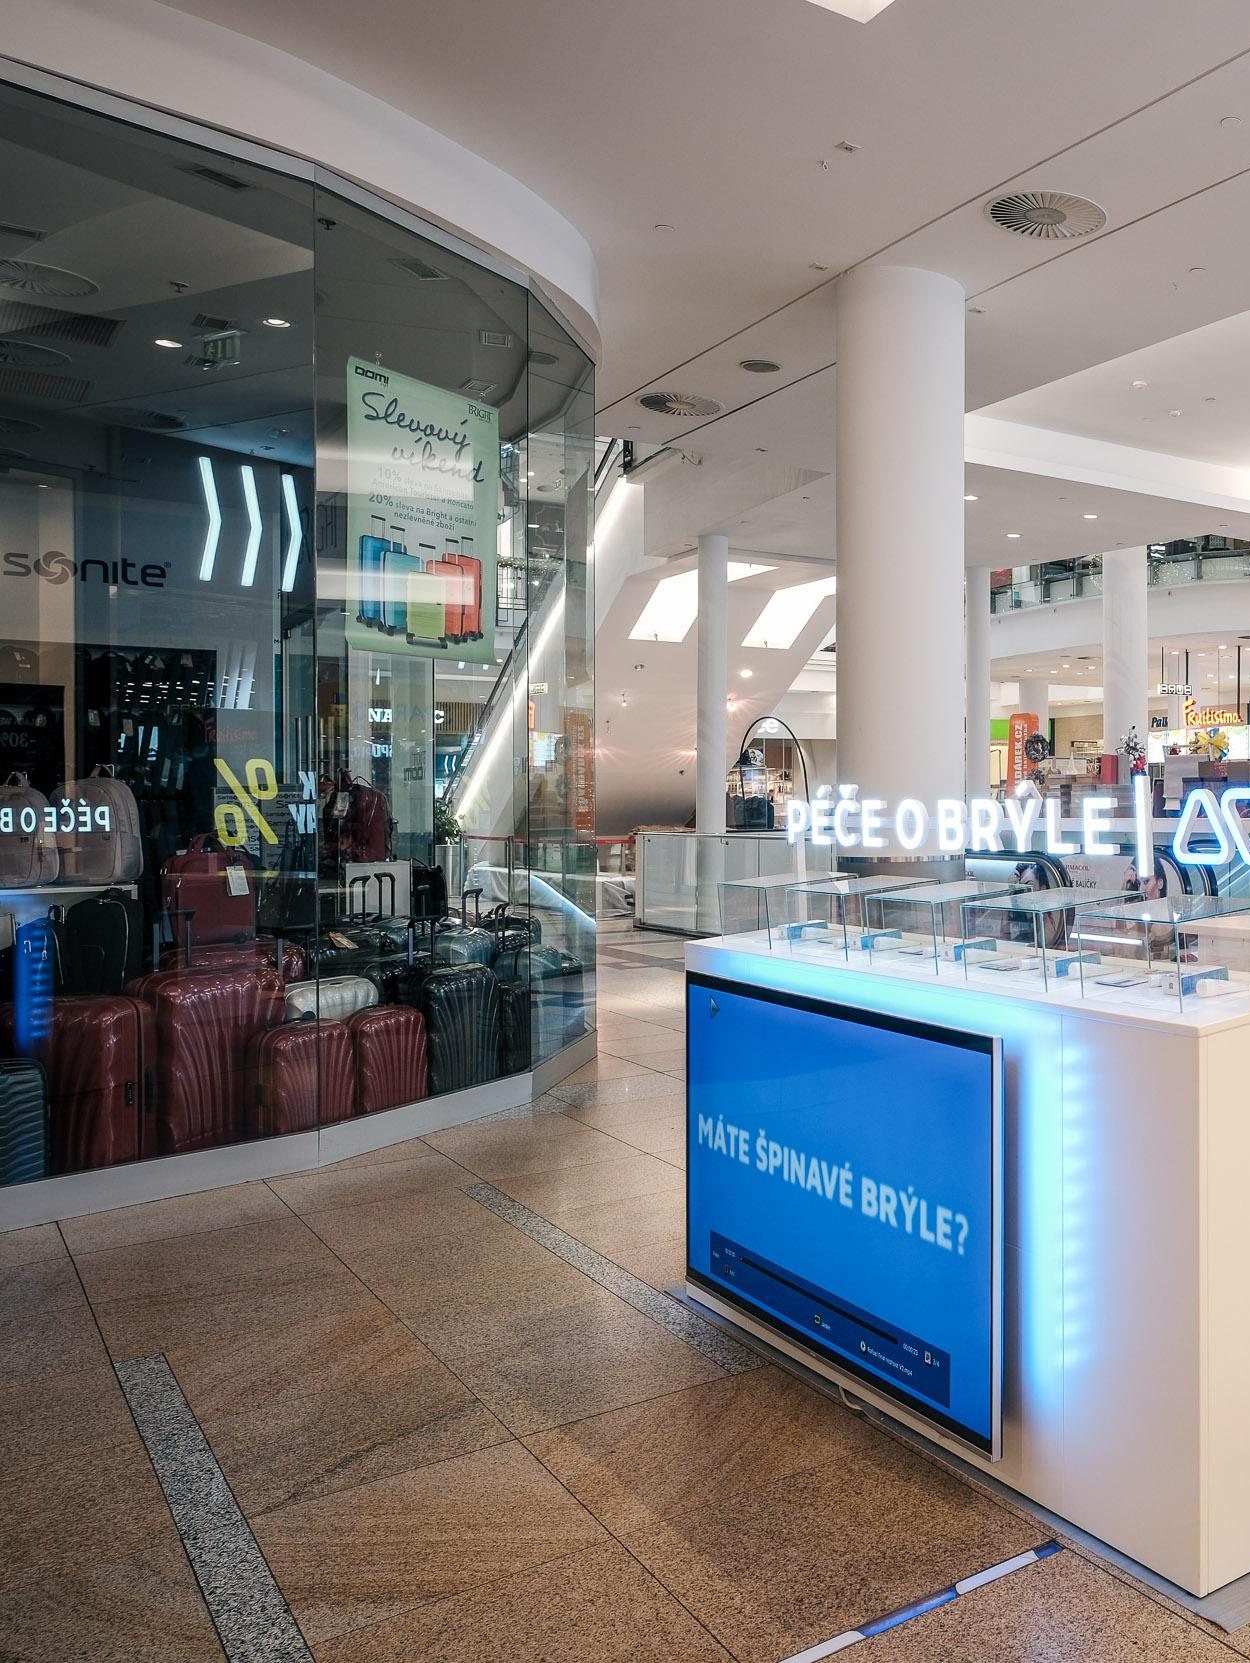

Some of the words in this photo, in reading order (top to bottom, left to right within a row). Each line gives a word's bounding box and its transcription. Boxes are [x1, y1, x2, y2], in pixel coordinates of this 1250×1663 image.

[362, 392, 471, 461] Slevový
[392, 437, 485, 483] víkend
[368, 491, 394, 508] 20%
[395, 501, 415, 513] sleva
[416, 506, 425, 515] na
[426, 506, 448, 521] Bright
[454, 514, 477, 528] ostatní
[786, 784, 891, 847] PÉČE
[896, 797, 929, 850] O
[938, 779, 1121, 856] BRÝLE
[697, 1113, 750, 1166] MÁTE
[755, 1127, 853, 1208] ŠPINAVÉ
[860, 1177, 970, 1256] BRÝLE?
